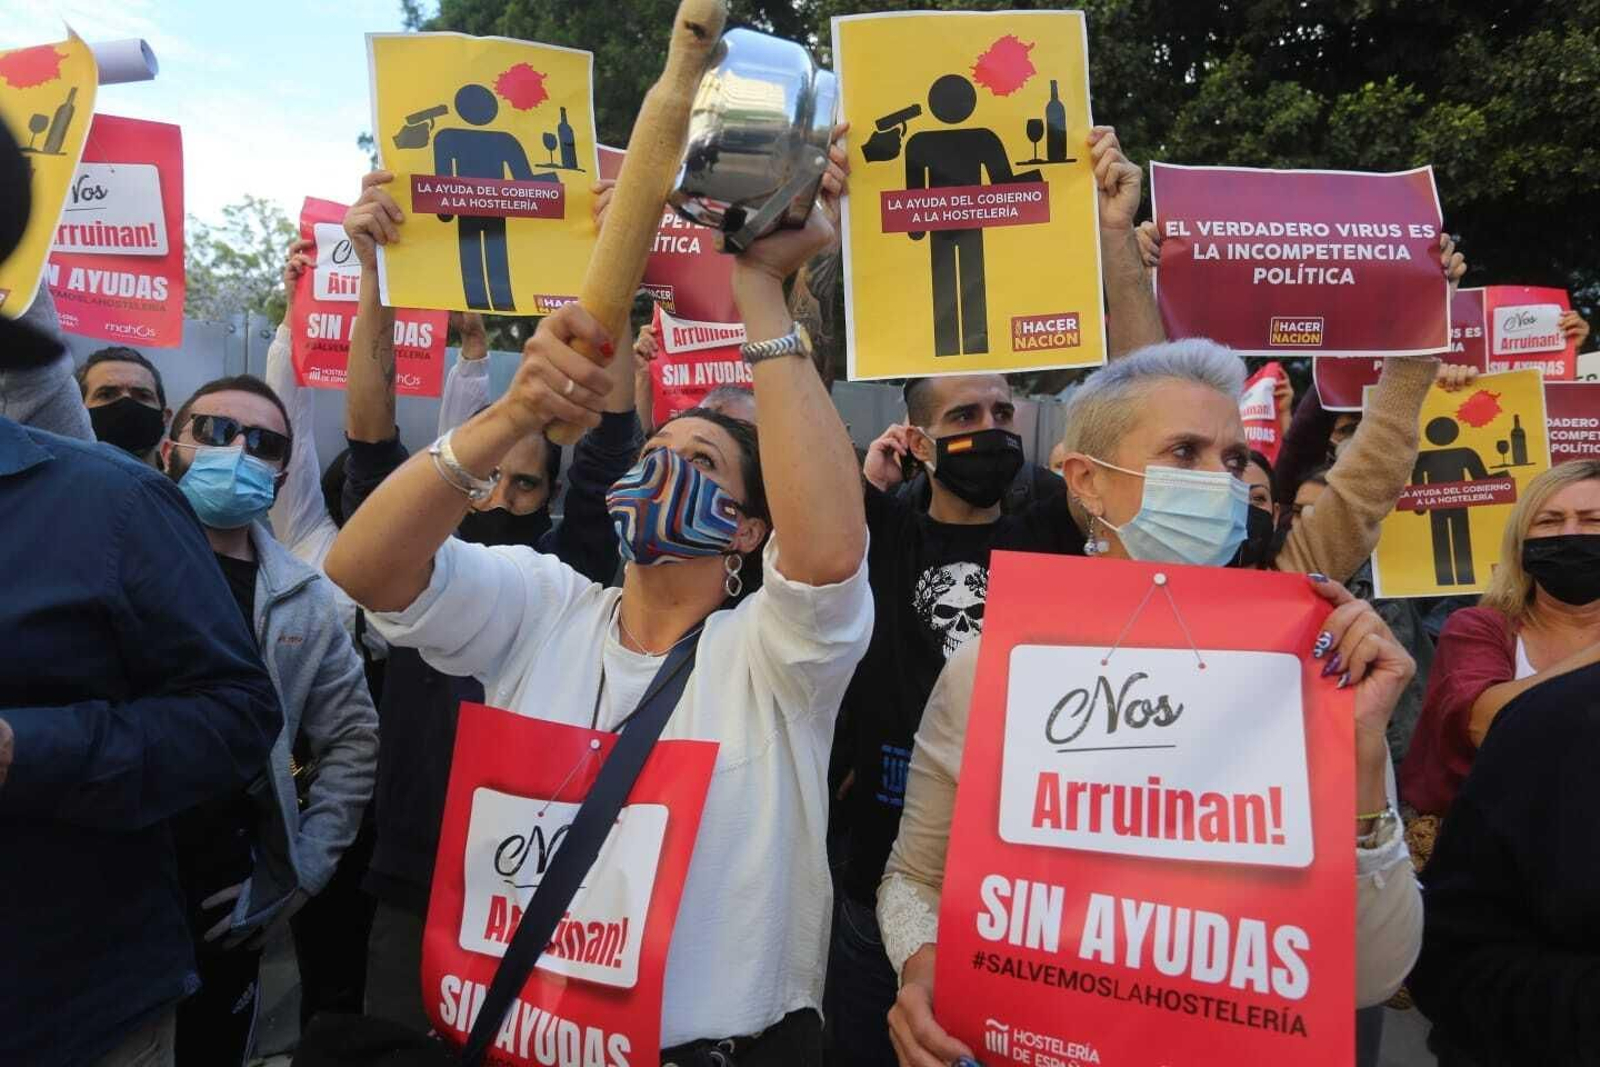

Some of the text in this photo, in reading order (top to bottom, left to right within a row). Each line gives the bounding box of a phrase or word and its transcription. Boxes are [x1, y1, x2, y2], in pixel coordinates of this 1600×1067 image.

[417, 183, 559, 200] LA AYUDA DEL GOBIERNO
[888, 191, 1042, 210] LA AYUDA DEL GOBIERNO
[441, 198, 538, 211] A LA HOSTELERÍA
[912, 205, 1019, 223] A LA HOSTELERÍA
[54, 220, 158, 248] rruinan!
[1165, 221, 1436, 239] EL VERDADERO VIRUS ES
[650, 231, 701, 253] ÍTICA
[1193, 243, 1412, 260] LA INCOMPETENCIA
[1253, 263, 1355, 285] POLÍTICA
[68, 267, 169, 301] AYUDAS
[307, 313, 342, 340] SIN
[1022, 318, 1077, 334] HACER
[1280, 321, 1321, 332] HACER
[1503, 311, 1538, 330] Nos
[1014, 330, 1079, 349] NACIÓN
[1272, 331, 1320, 343] NACIÓN
[1465, 327, 1482, 338] ES
[662, 361, 754, 386] SIN AYUDAS
[1412, 488, 1442, 497] AYUDA
[1444, 486, 1461, 495] DEL
[1462, 483, 1511, 493] GOBIERNO
[1416, 492, 1494, 506] A LA HOSTELERÍA
[1045, 672, 1184, 745] Nos
[1031, 771, 1287, 846] Arruinan!
[976, 874, 1310, 1000] SIN AYUDAS
[972, 951, 1308, 1038] #SALVEMOSLAHOSTELERÍA
[1012, 1047, 1031, 1064] DE
[1013, 1028, 1100, 1064] HOSTELERÍA
